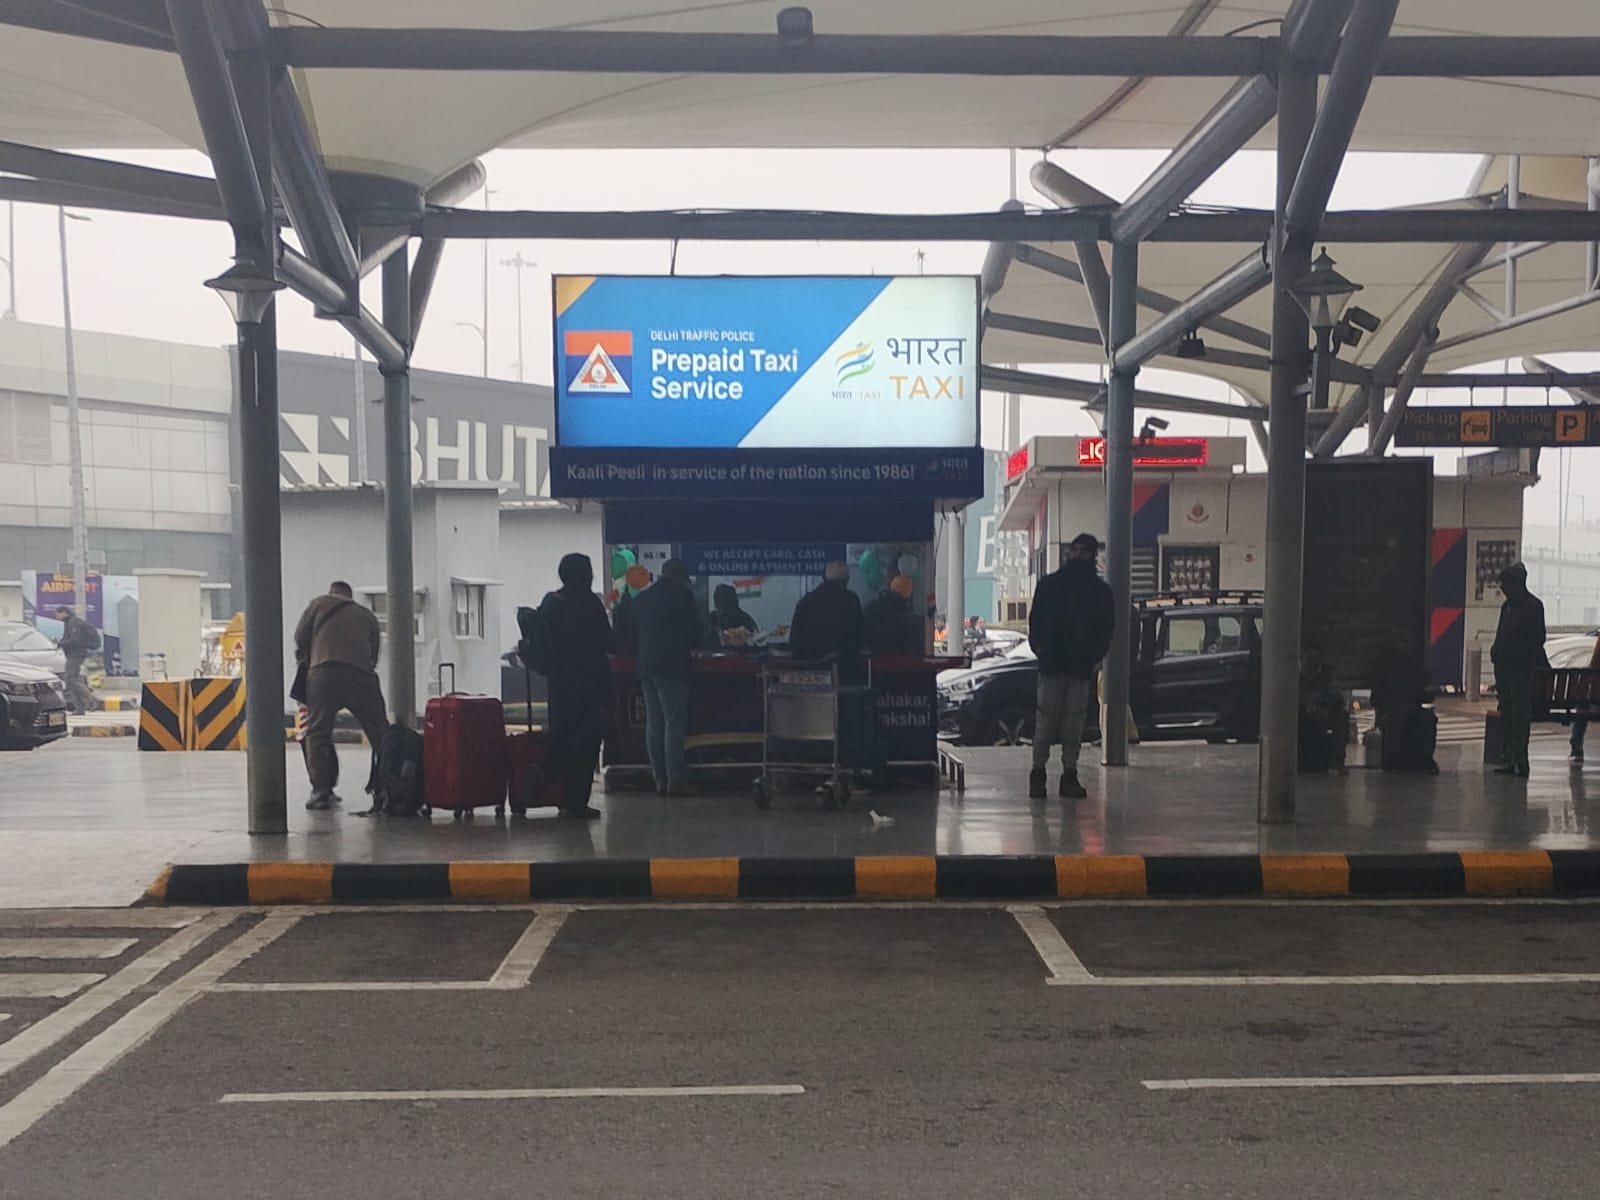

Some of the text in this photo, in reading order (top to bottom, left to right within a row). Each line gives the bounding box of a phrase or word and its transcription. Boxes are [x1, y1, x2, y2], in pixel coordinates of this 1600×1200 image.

[651, 330, 756, 342] DELHI TRAFFIC POLICE
[886, 337, 967, 365] भारत
[651, 348, 798, 377] Prepaid Taxi
[651, 375, 743, 399] Service
[889, 375, 964, 400] TAXI
[1404, 410, 1456, 429] Pick-up
[1496, 409, 1549, 429] Parking
[411, 416, 550, 497] HUT
[652, 464, 666, 480] in
[669, 464, 726, 480] service
[730, 463, 747, 480] of
[749, 464, 775, 480] the
[779, 464, 827, 480] nation
[830, 464, 871, 480] since
[874, 464, 915, 480] 1986!
[703, 549, 719, 559] WE
[722, 549, 760, 559] ACCEPT
[798, 549, 826, 559] CASH
[708, 561, 749, 571] ONLINE
[752, 561, 802, 571] PAYMENT
[805, 561, 826, 571] HER
[41, 581, 97, 592] AIRPRT
